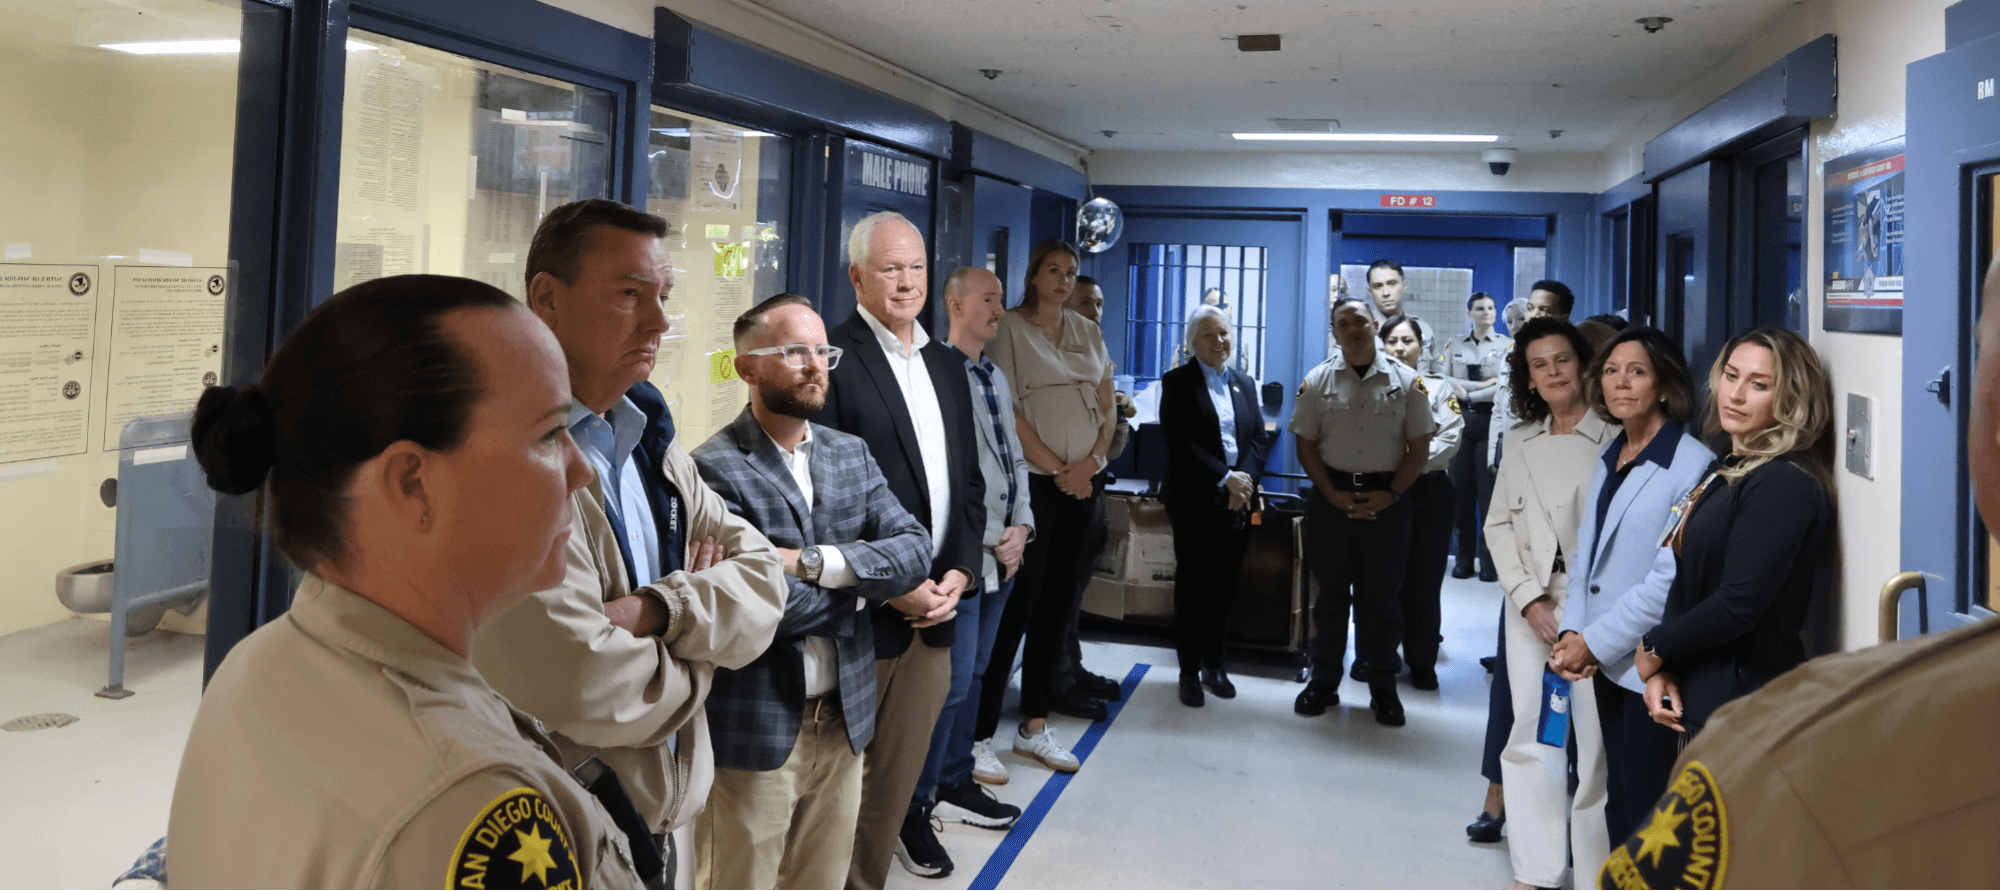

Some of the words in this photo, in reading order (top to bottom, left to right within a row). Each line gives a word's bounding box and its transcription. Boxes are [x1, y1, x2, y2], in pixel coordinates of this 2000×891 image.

[1977, 78, 1995, 100] RM
[862, 152, 892, 190] MALE
[894, 160, 927, 196] PHONE
[1390, 196, 1405, 206] FD
[1409, 196, 1418, 206] #
[1422, 196, 1433, 206] 12
[475, 797, 531, 849] DIEGO
[1682, 801, 1716, 889] COUNT
[461, 853, 490, 889] AN
